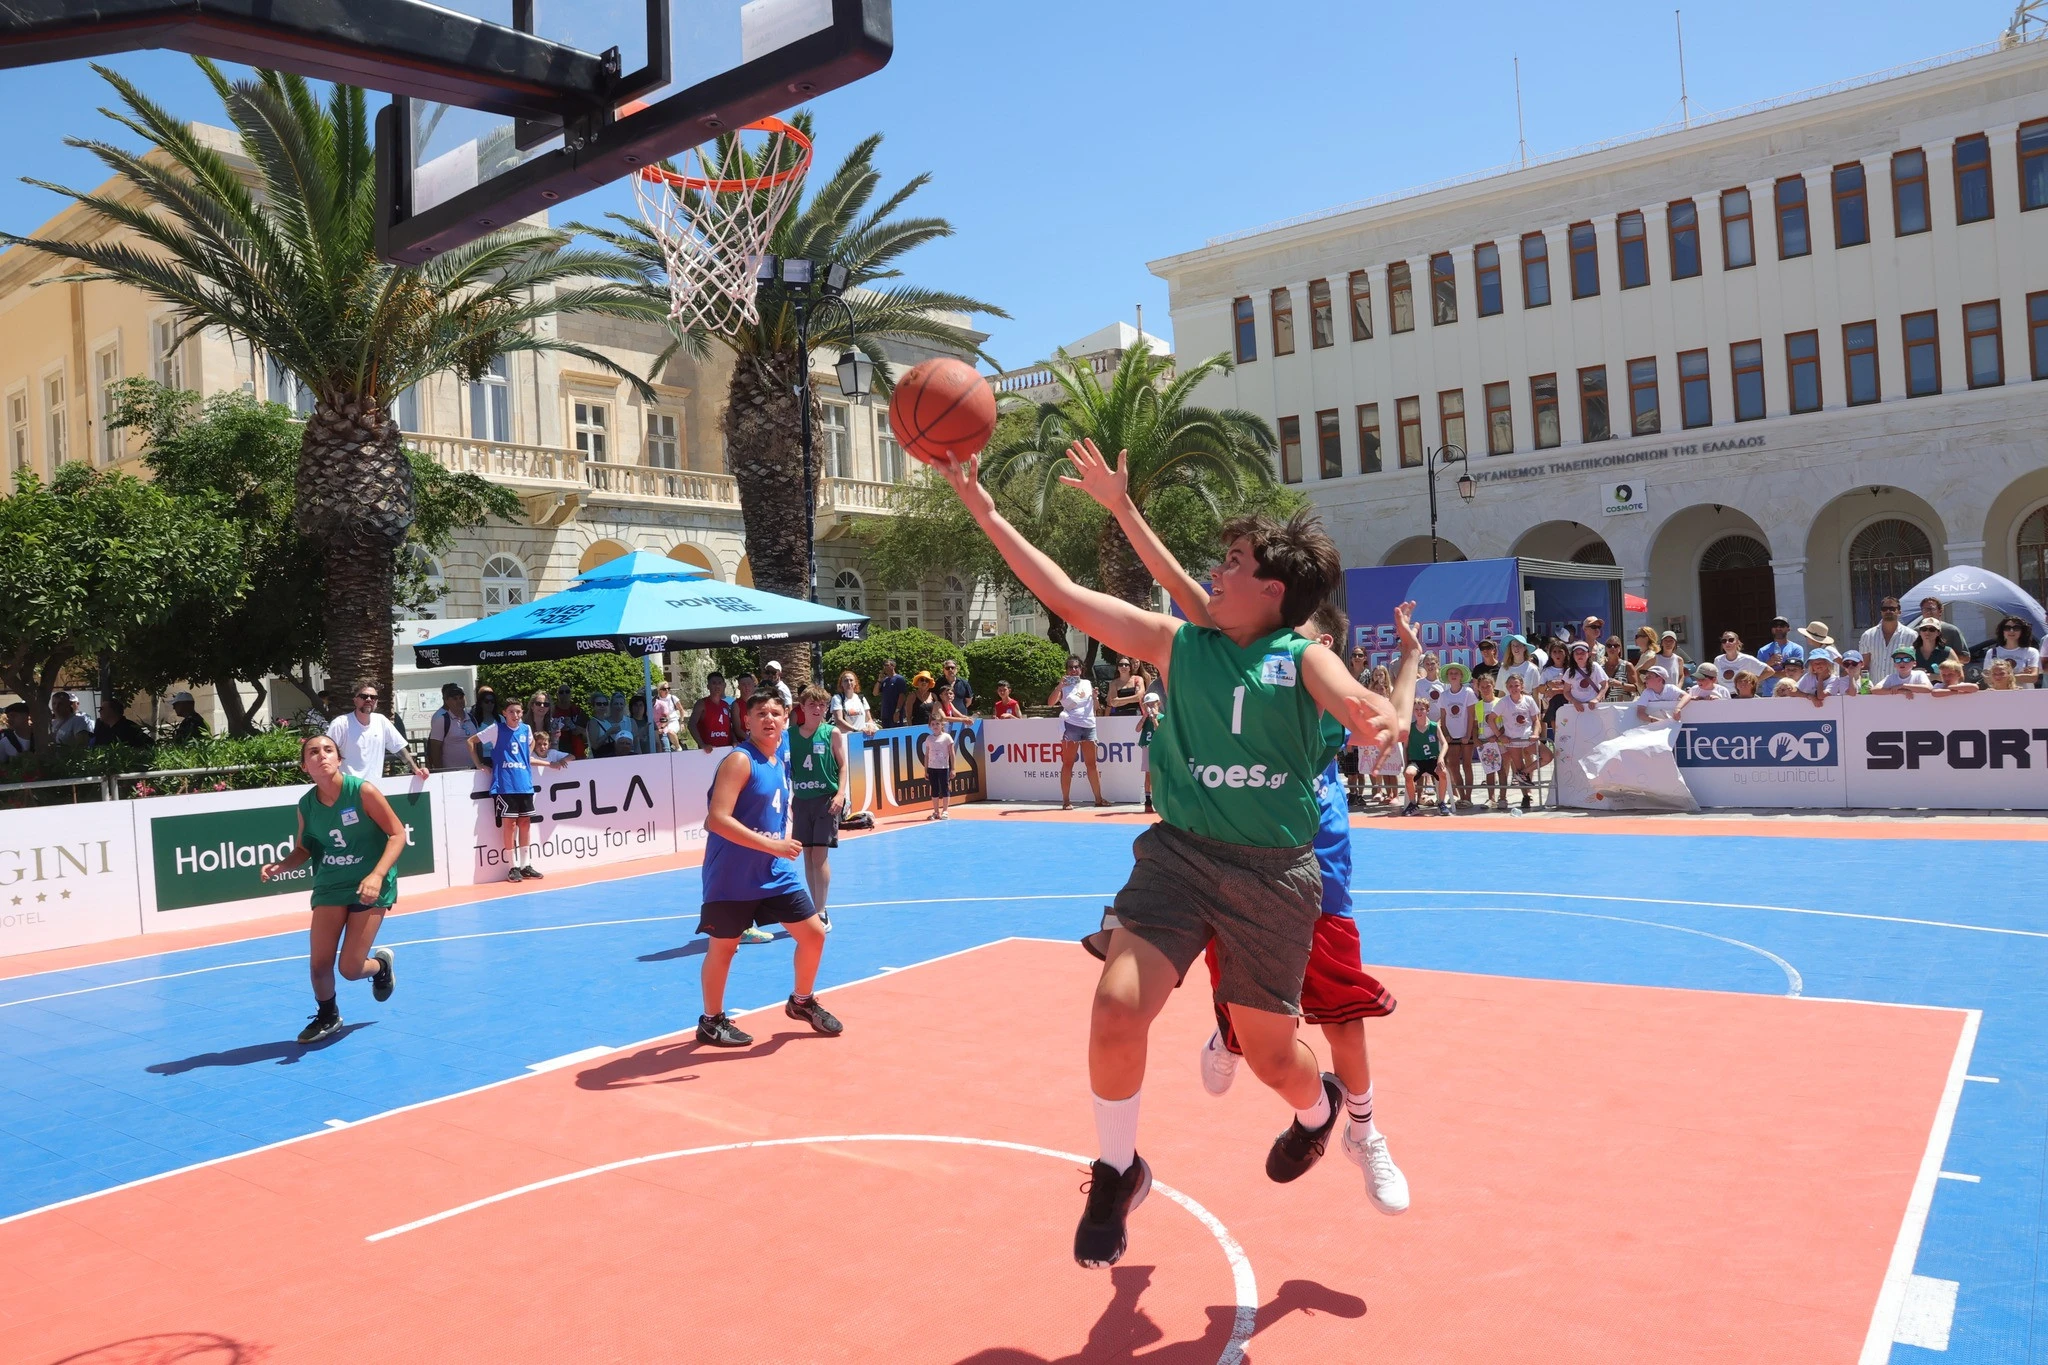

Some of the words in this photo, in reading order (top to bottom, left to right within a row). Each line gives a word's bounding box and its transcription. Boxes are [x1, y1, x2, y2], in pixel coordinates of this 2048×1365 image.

[1672, 444, 1699, 457] ΤΗΣ
[1605, 503, 1644, 513] COSMOTE
[1933, 582, 1988, 592] SENECA
[665, 596, 745, 609] POWER
[717, 603, 763, 613] ADE
[524, 604, 596, 619] POWER
[532, 614, 580, 624] ADE
[628, 635, 668, 646] POWER
[1354, 618, 1513, 647] ESORTS
[644, 642, 666, 652] ADE
[1231, 685, 1246, 735] 1
[511, 742, 519, 755] 3
[1422, 744, 1432, 756] 2
[1680, 727, 1762, 760] Tecar
[1007, 742, 1136, 763] INTERORT
[802, 754, 813, 771] 4
[1188, 757, 1289, 789] iroes.gr
[771, 788, 781, 814] 4
[897, 784, 932, 802] DIGIT
[470, 774, 654, 829] TSLA
[328, 829, 347, 848] 3
[604, 827, 632, 848] for
[636, 820, 657, 844] all
[175, 834, 295, 875] Holland
[0, 912, 46, 928] OTEL
